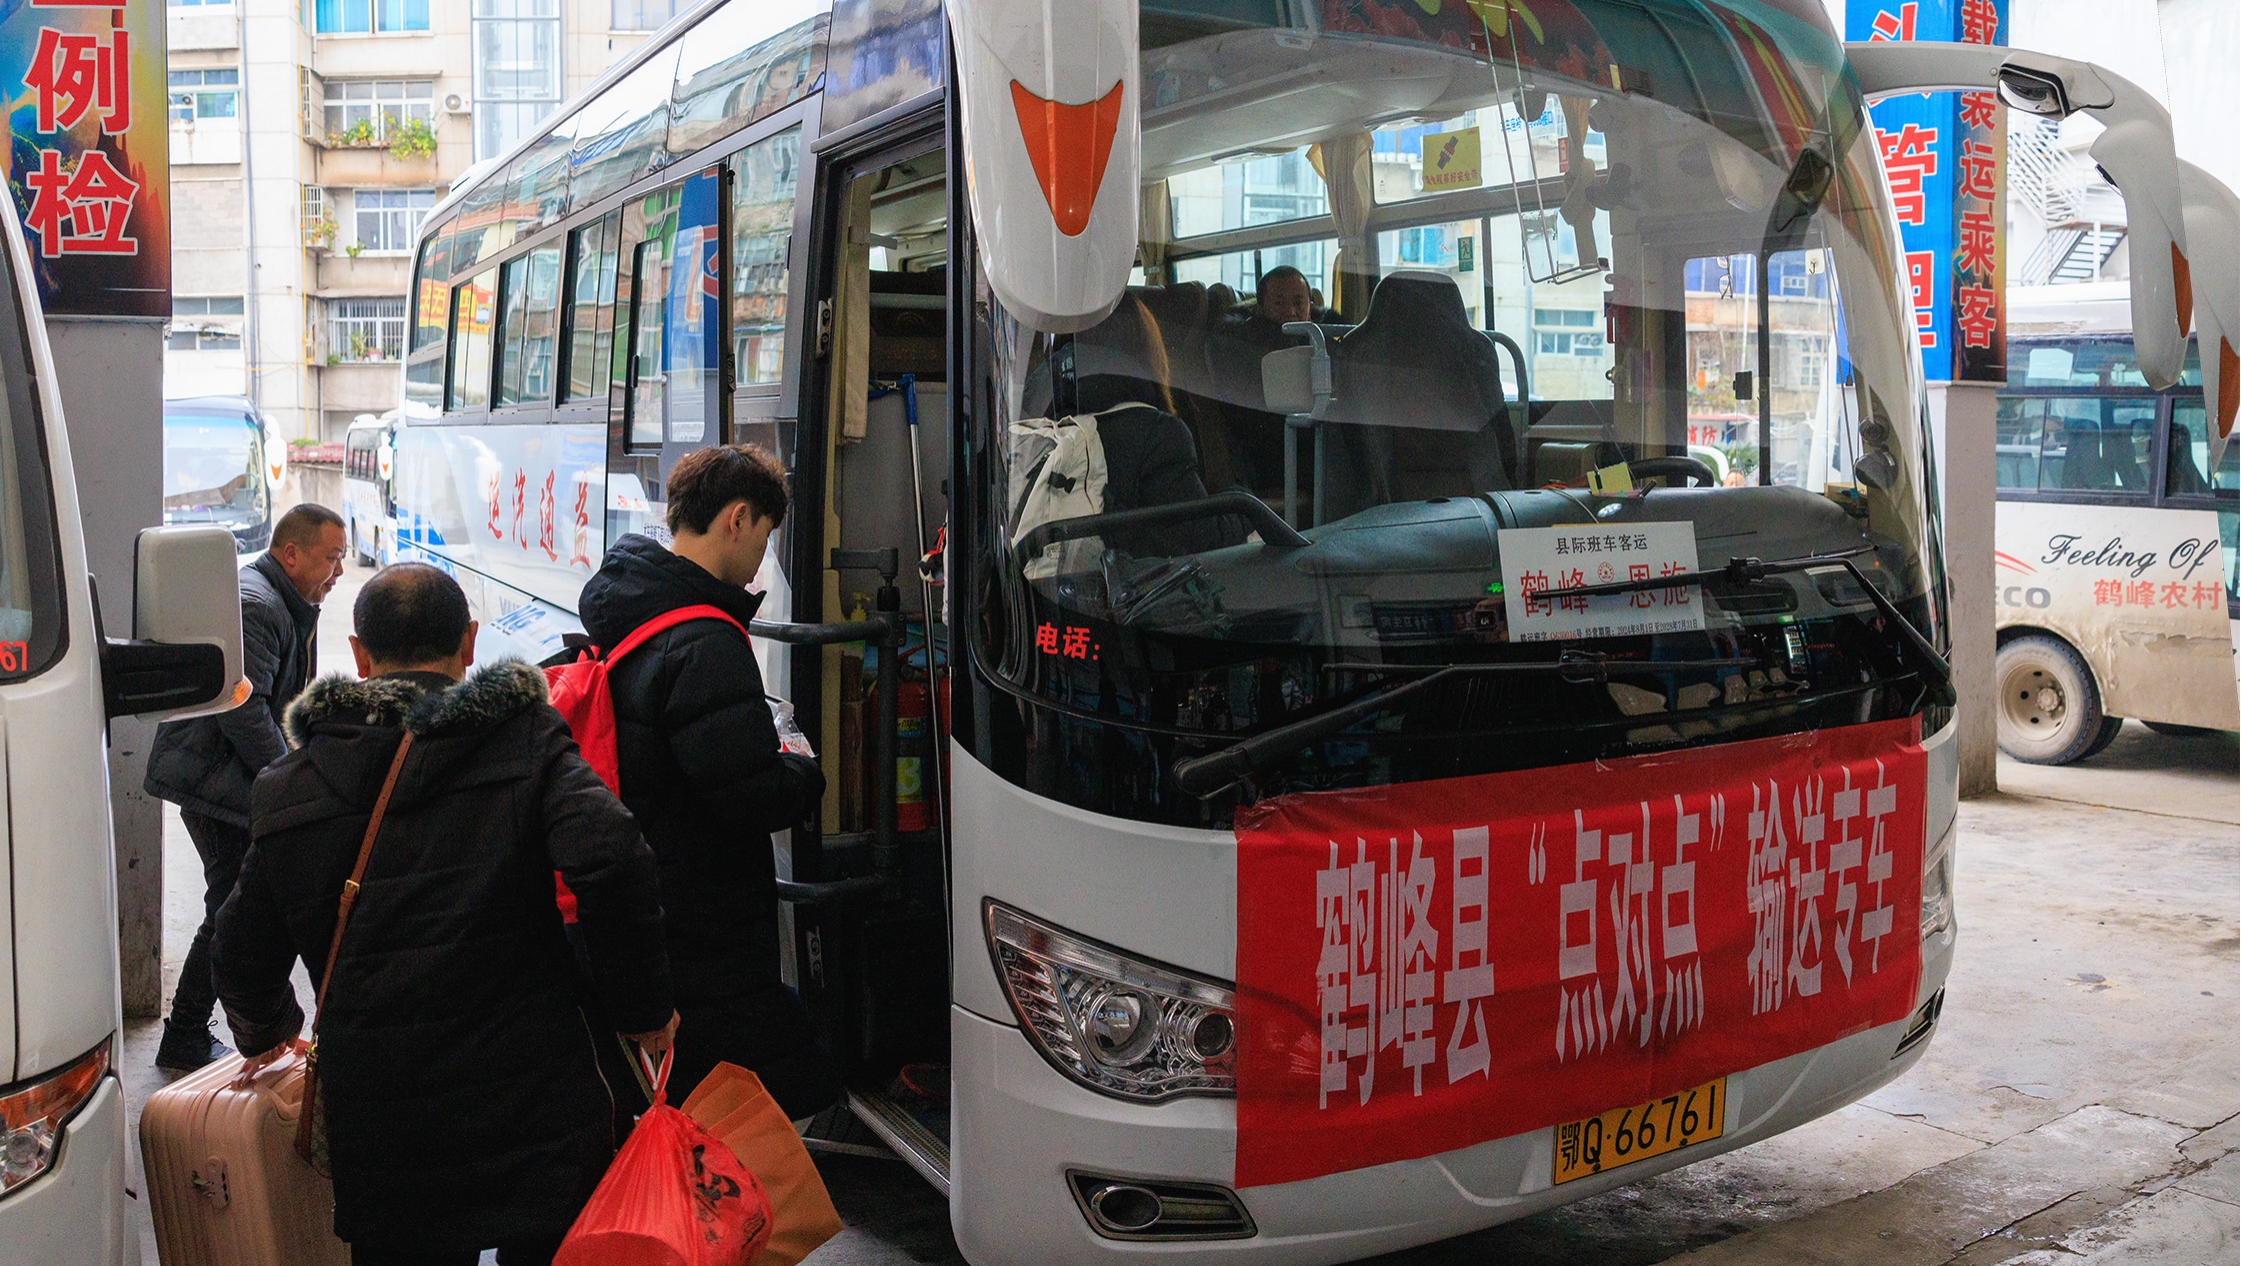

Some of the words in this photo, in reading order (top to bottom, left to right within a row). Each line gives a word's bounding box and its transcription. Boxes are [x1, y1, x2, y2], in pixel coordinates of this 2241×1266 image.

[22, 0, 140, 258] 例检
[1555, 533, 1649, 555] 县际班车客运
[2041, 533, 2157, 579] Feeling
[2168, 538, 2219, 581] Of
[1520, 567, 1590, 618] 鹤峰
[1629, 560, 1690, 609] 恩施
[1995, 585, 2051, 610] CO
[2093, 578, 2223, 611] 鹤峰农村
